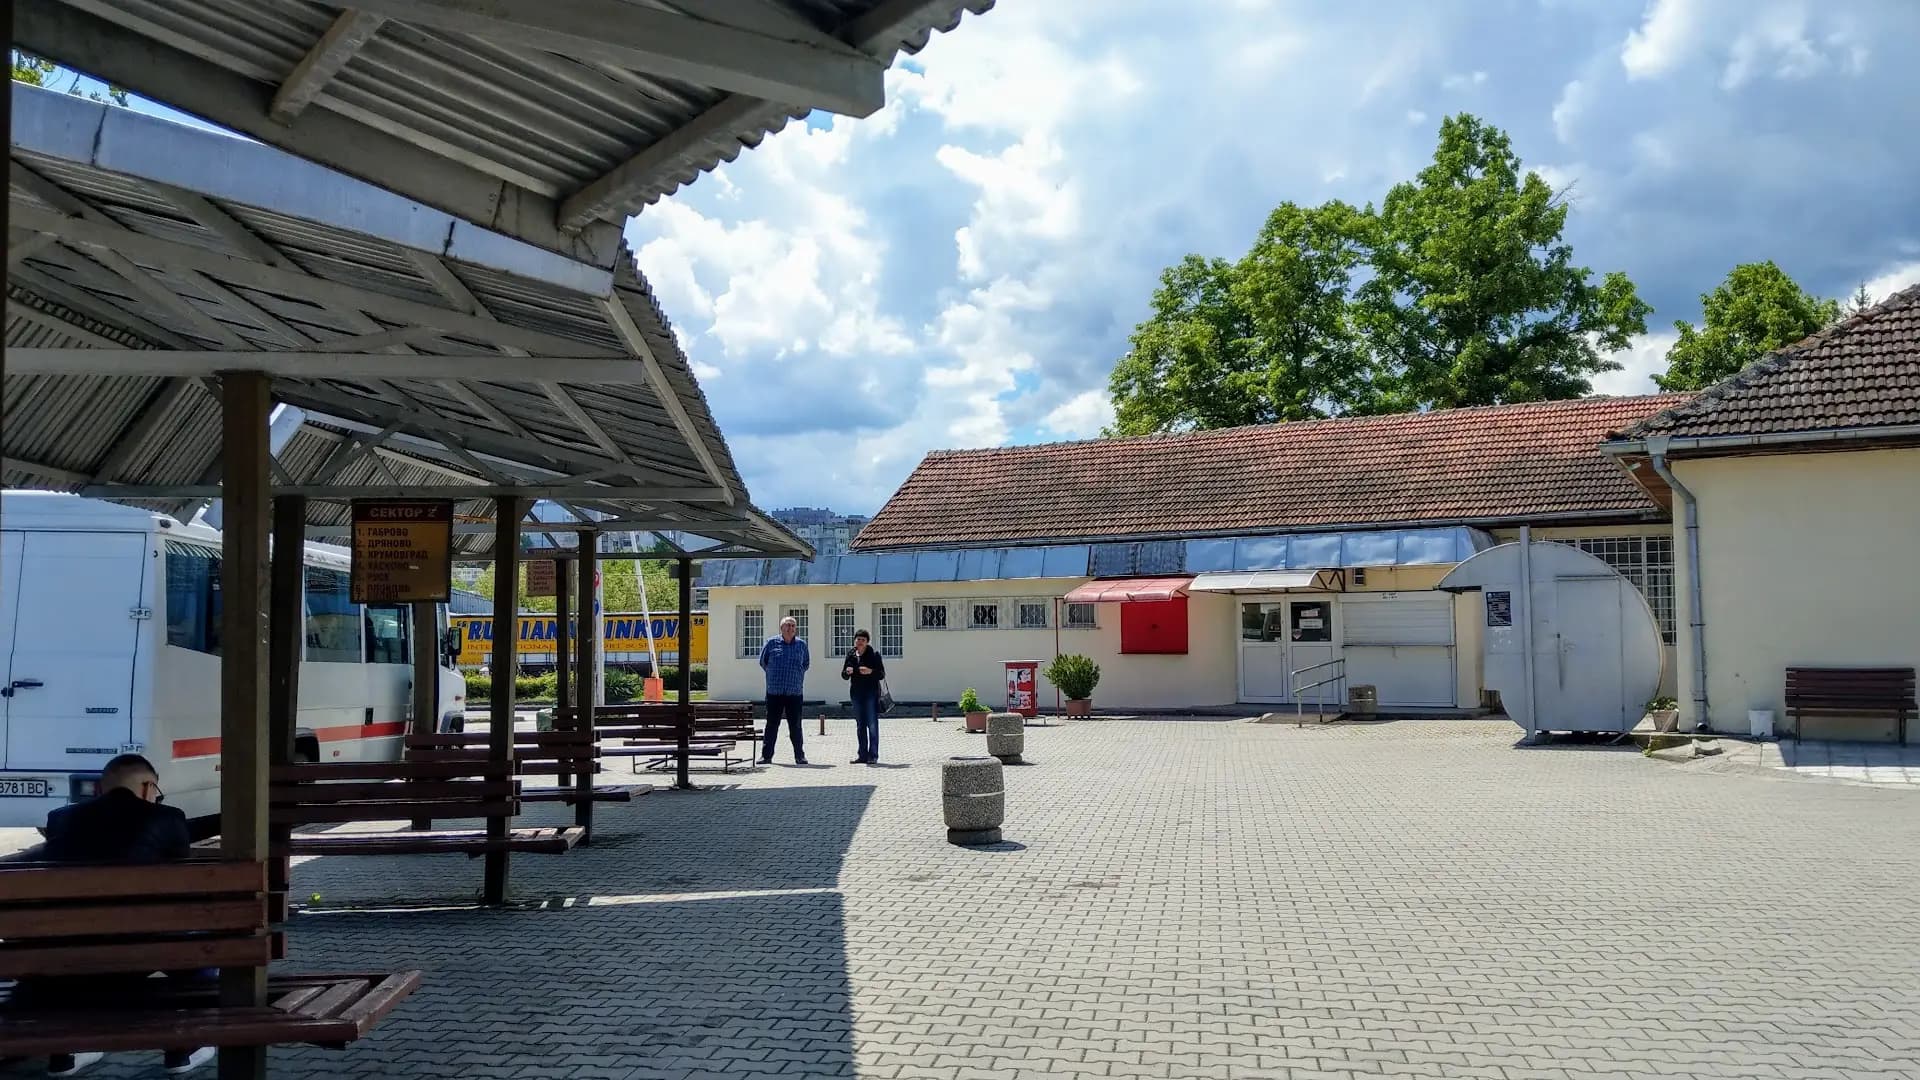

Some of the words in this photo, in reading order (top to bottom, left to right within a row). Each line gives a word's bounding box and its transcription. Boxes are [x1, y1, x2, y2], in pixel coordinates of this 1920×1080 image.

[370, 507, 423, 518] СЕКТОР
[367, 527, 409, 537] ГАБРОВО
[367, 538, 412, 548] ДРЯНОВО
[367, 550, 429, 560] КРУМОВГРАД
